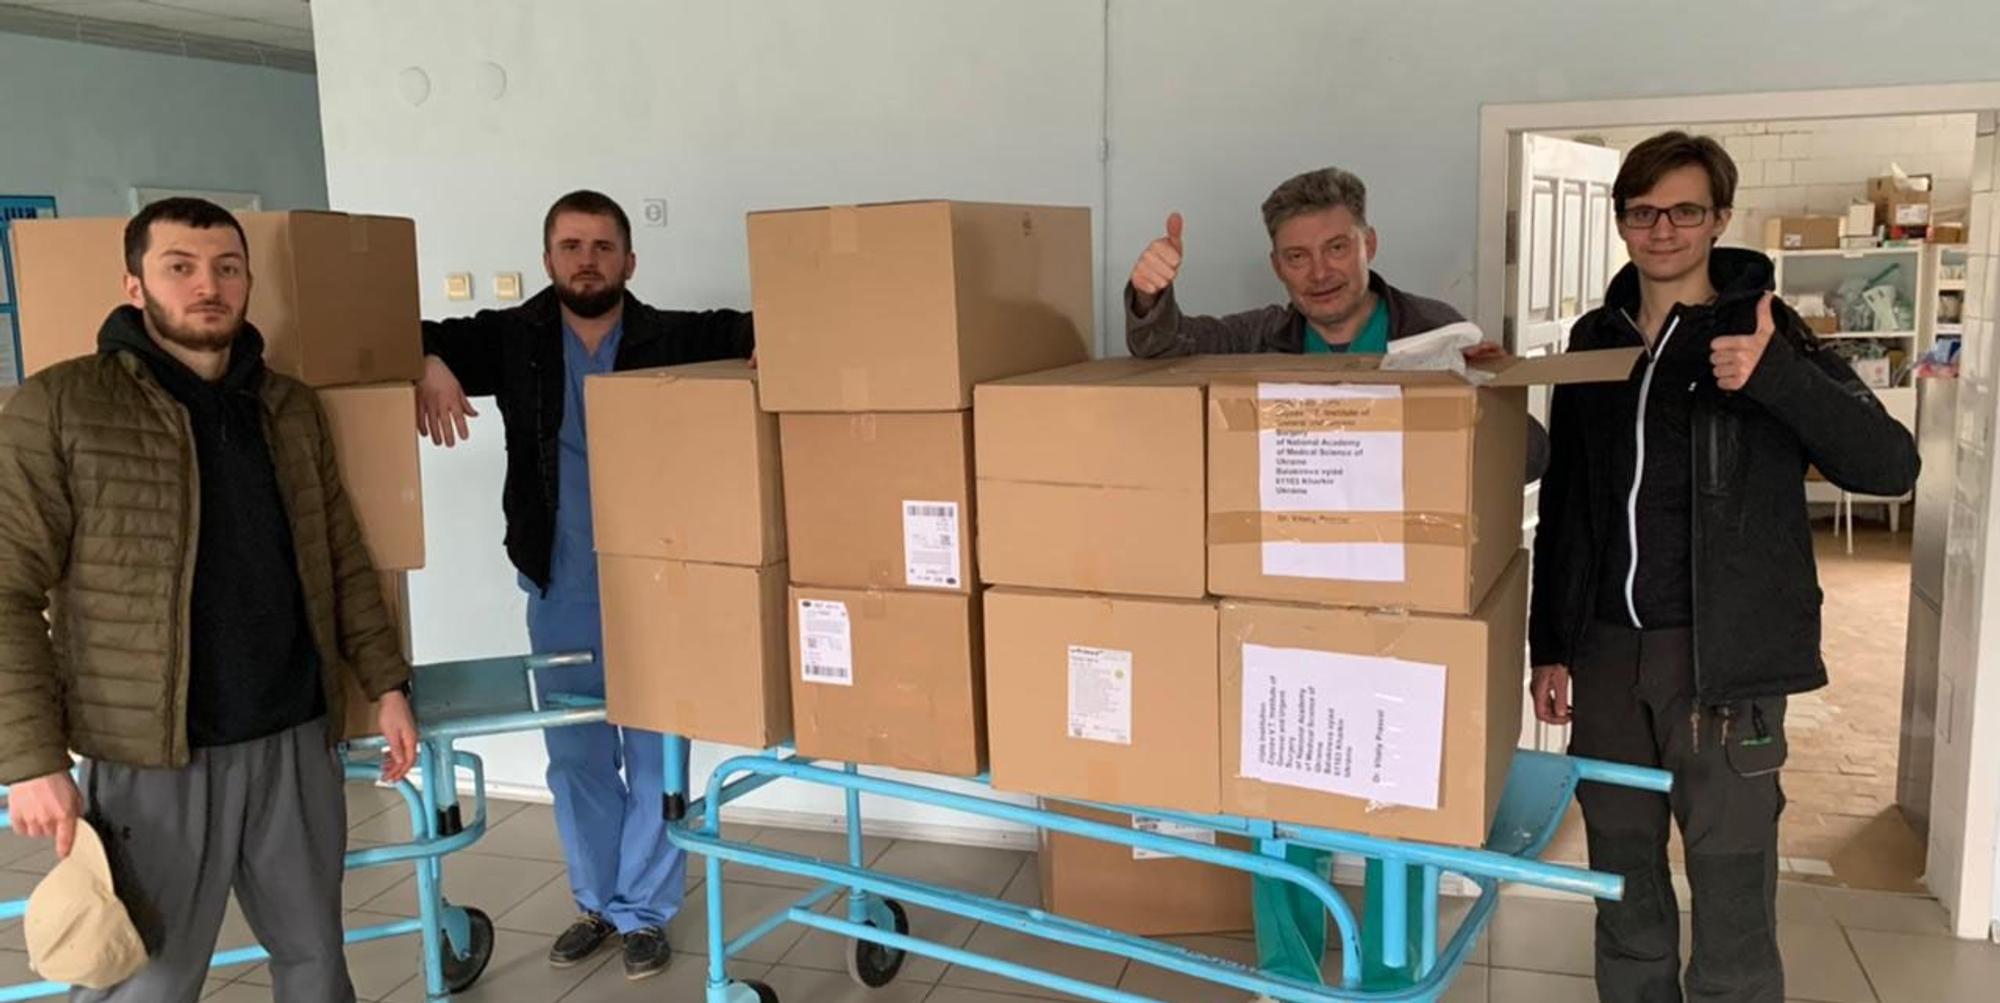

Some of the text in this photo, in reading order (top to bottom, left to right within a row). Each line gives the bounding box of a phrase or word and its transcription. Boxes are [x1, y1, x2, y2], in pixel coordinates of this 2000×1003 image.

[1276, 438, 1362, 448] of National Academy
[1276, 448, 1285, 456] of
[1286, 448, 1319, 456] Medical
[1319, 448, 1353, 456] Science
[1276, 487, 1309, 495] Ukraine
[1297, 686, 1308, 726] Academy
[1296, 726, 1305, 760] National
[1306, 729, 1314, 762] Medical
